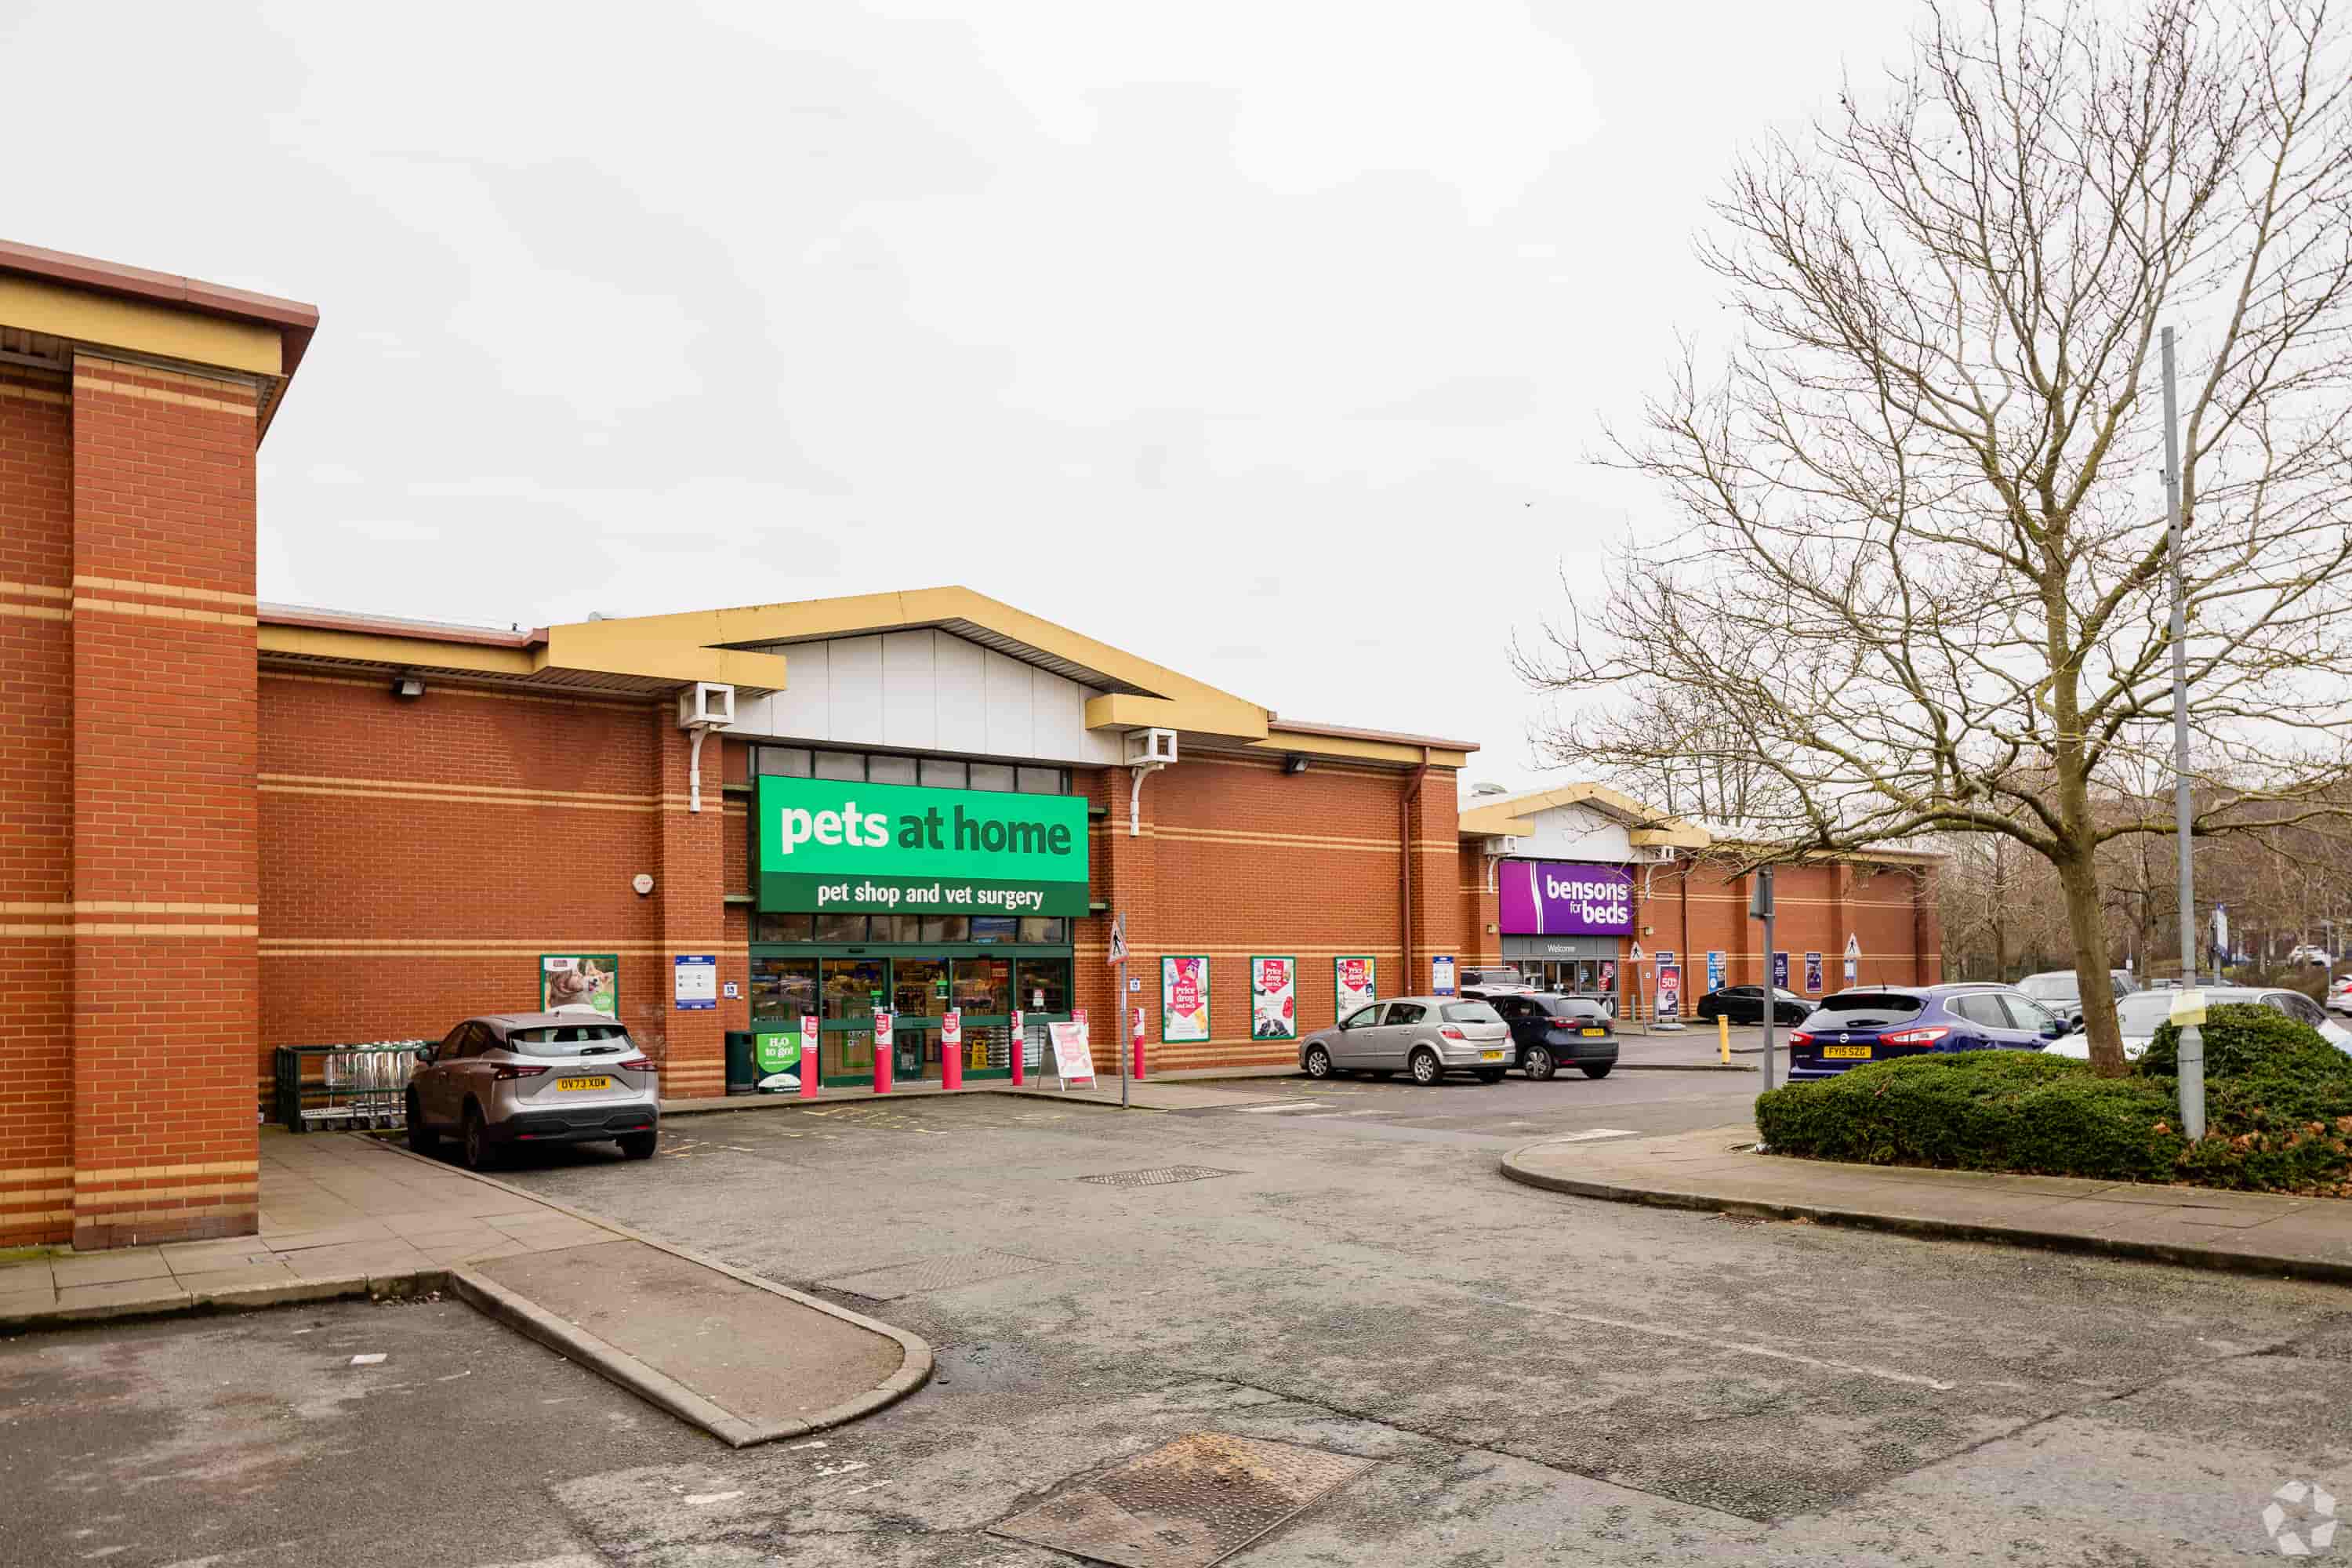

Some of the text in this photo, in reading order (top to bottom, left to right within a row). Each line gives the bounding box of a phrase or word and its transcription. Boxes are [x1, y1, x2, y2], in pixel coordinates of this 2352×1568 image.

[781, 801, 1072, 855] pets at home
[818, 881, 1044, 910] pet shop and vet surgery
[1547, 874, 1628, 901] bensons
[1570, 901, 1628, 924] for beds
[1548, 943, 1576, 953] Welcome
[1176, 986, 1195, 995] Price
[1177, 995, 1195, 1004] drop
[765, 1047, 777, 1056] to
